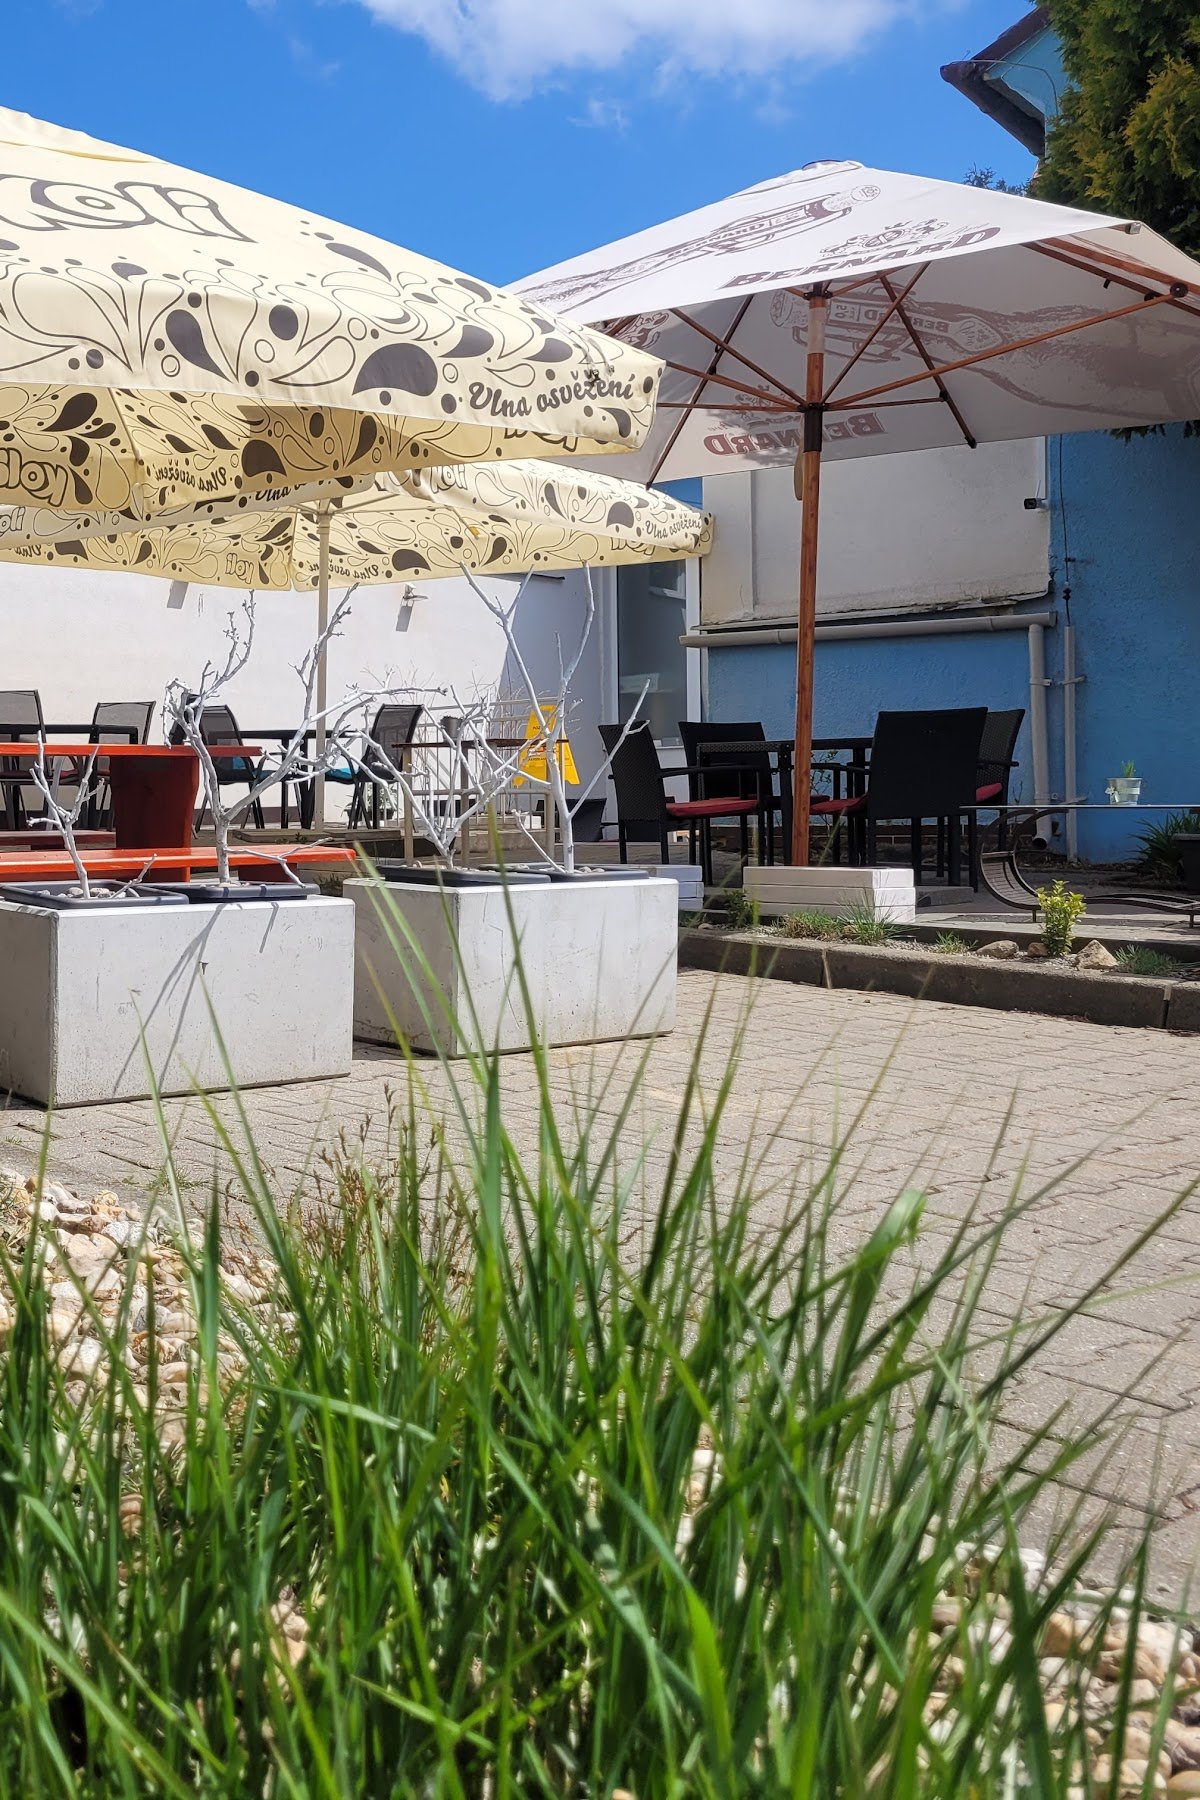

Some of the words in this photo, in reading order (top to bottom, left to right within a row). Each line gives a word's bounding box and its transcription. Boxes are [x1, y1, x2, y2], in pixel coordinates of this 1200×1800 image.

[716, 227, 1001, 290] BERNARD
[469, 382, 532, 417] Vlna
[537, 369, 636, 412] osvěžení
